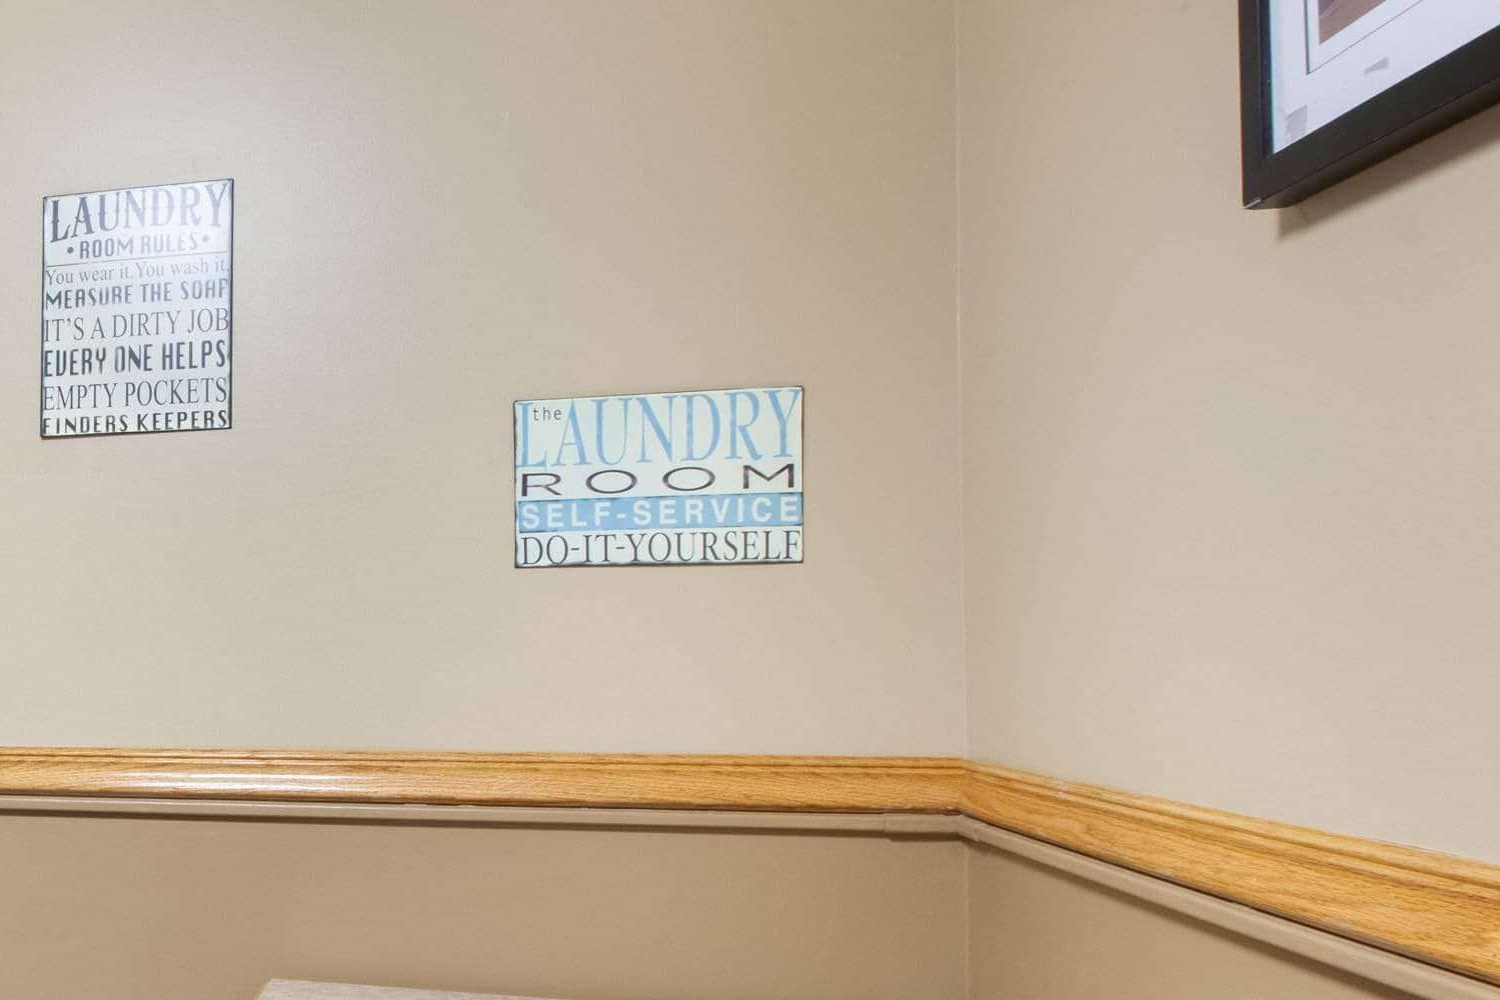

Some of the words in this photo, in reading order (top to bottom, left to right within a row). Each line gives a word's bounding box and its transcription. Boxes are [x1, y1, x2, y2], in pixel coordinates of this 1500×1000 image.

[50, 182, 229, 243] LAUNDRY
[79, 235, 134, 260] ROOM
[140, 232, 198, 255] RULES
[45, 269, 75, 286] You
[79, 269, 115, 281] wear
[134, 262, 165, 279] You
[170, 258, 209, 275] wash
[45, 284, 132, 310] MEASURE
[142, 282, 173, 303] THE
[181, 278, 228, 300] SOAP
[44, 317, 85, 342] IT'S
[90, 317, 105, 340] A
[112, 310, 181, 338] DIRTY
[188, 307, 228, 333] JOB
[44, 347, 107, 377] EVERY
[114, 344, 152, 373] ONE
[162, 339, 226, 370] HELPS
[44, 382, 119, 411] EMPTY
[124, 377, 227, 407] POCKETS
[43, 414, 129, 434] FINDERS
[136, 410, 228, 431] KEEPERS
[516, 389, 800, 469] LAUNDRY
[533, 406, 562, 421] the
[521, 463, 794, 496] ROOM
[522, 496, 801, 529] SELF-SERVICE
[520, 530, 800, 565] DO-IT-YOURSELF
